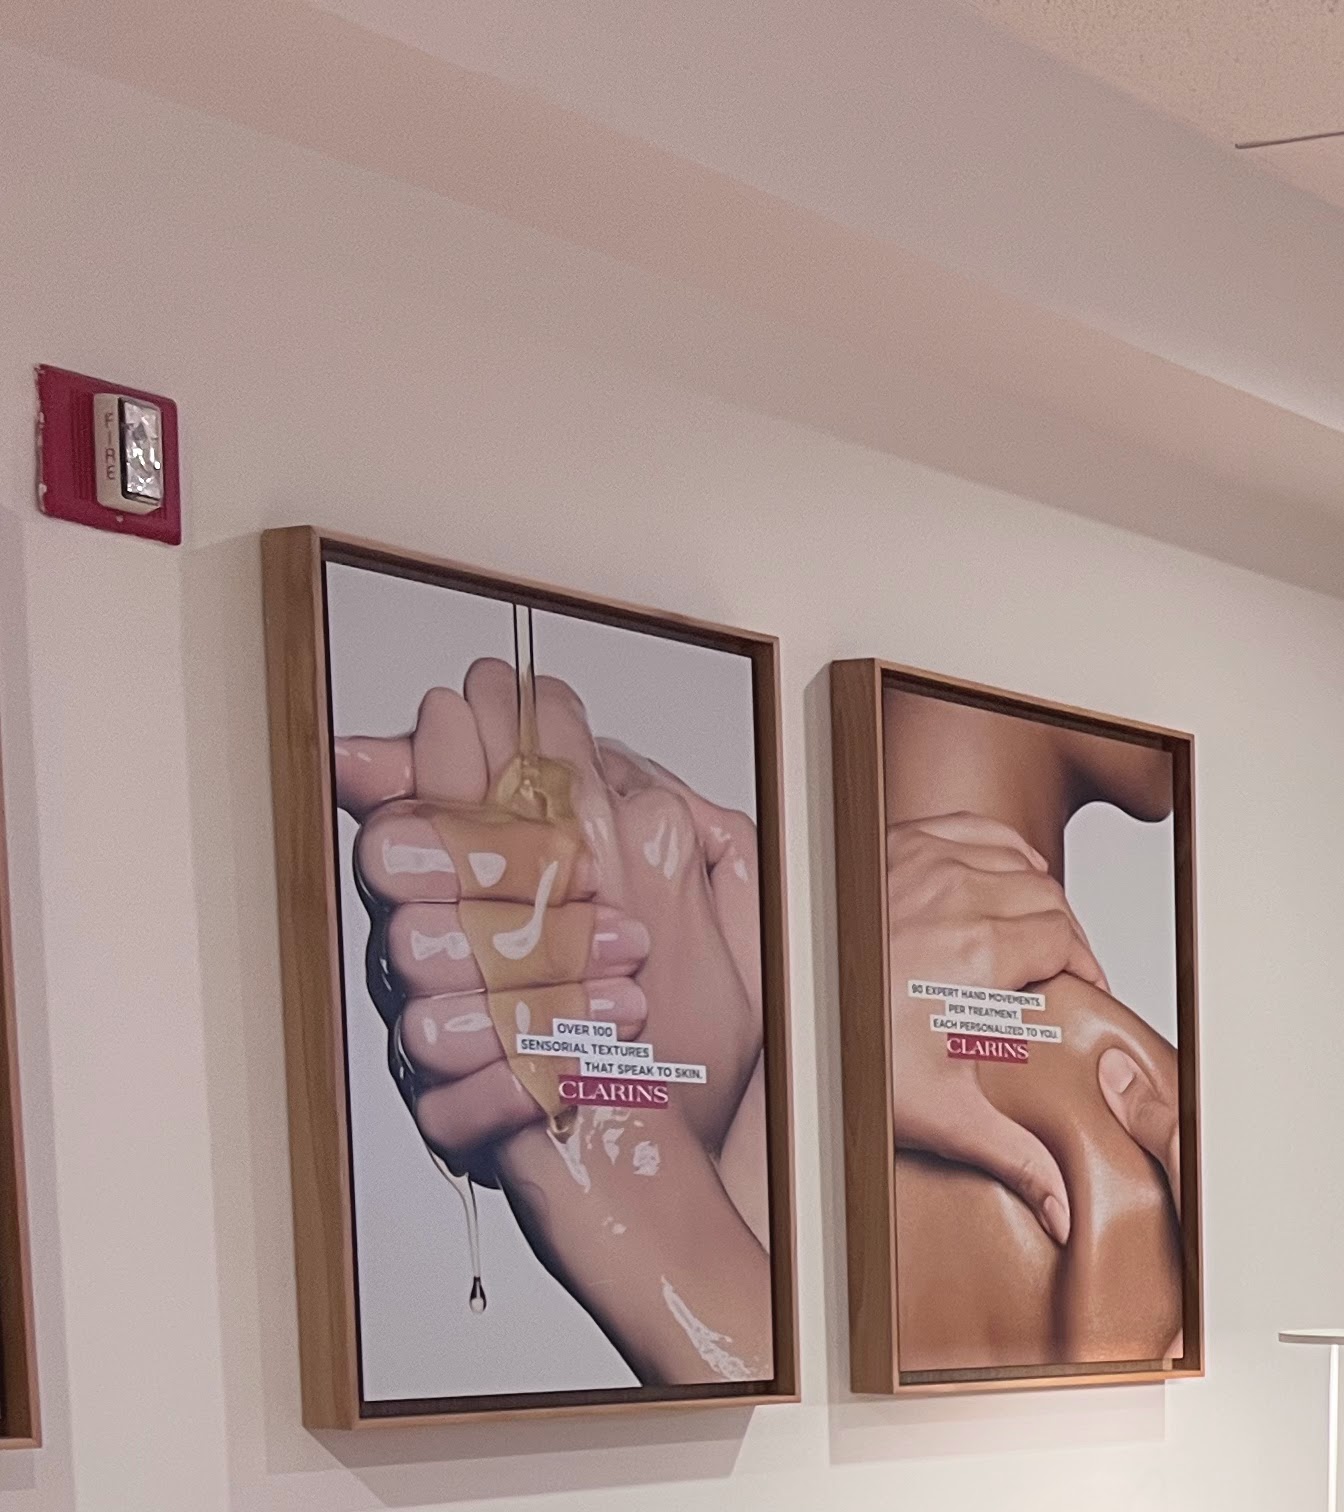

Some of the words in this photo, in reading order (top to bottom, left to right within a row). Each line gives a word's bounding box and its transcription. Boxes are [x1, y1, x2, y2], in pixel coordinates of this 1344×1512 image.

[105, 412, 116, 480] FIRE
[925, 985, 959, 998] EXPERT
[961, 989, 986, 1001] HAND
[948, 1004, 966, 1015] PER
[968, 1006, 1019, 1020] TREATMENT.
[557, 1022, 590, 1036] OVER
[592, 1025, 613, 1037] 100
[933, 1018, 957, 1030] EACH
[959, 1021, 1024, 1036] PERSONALIZED
[1026, 1027, 1038, 1037] TO
[1040, 1029, 1058, 1039] YOU.
[521, 1038, 588, 1054] SENSORIAL
[591, 1043, 650, 1058] TEXTURES
[946, 1037, 1030, 1060] CLARINS
[585, 1061, 614, 1074] THAT
[617, 1065, 653, 1077] SPEAK
[657, 1067, 672, 1078] TO
[674, 1069, 703, 1080] SKIN.
[558, 1080, 669, 1104] CLARINS
